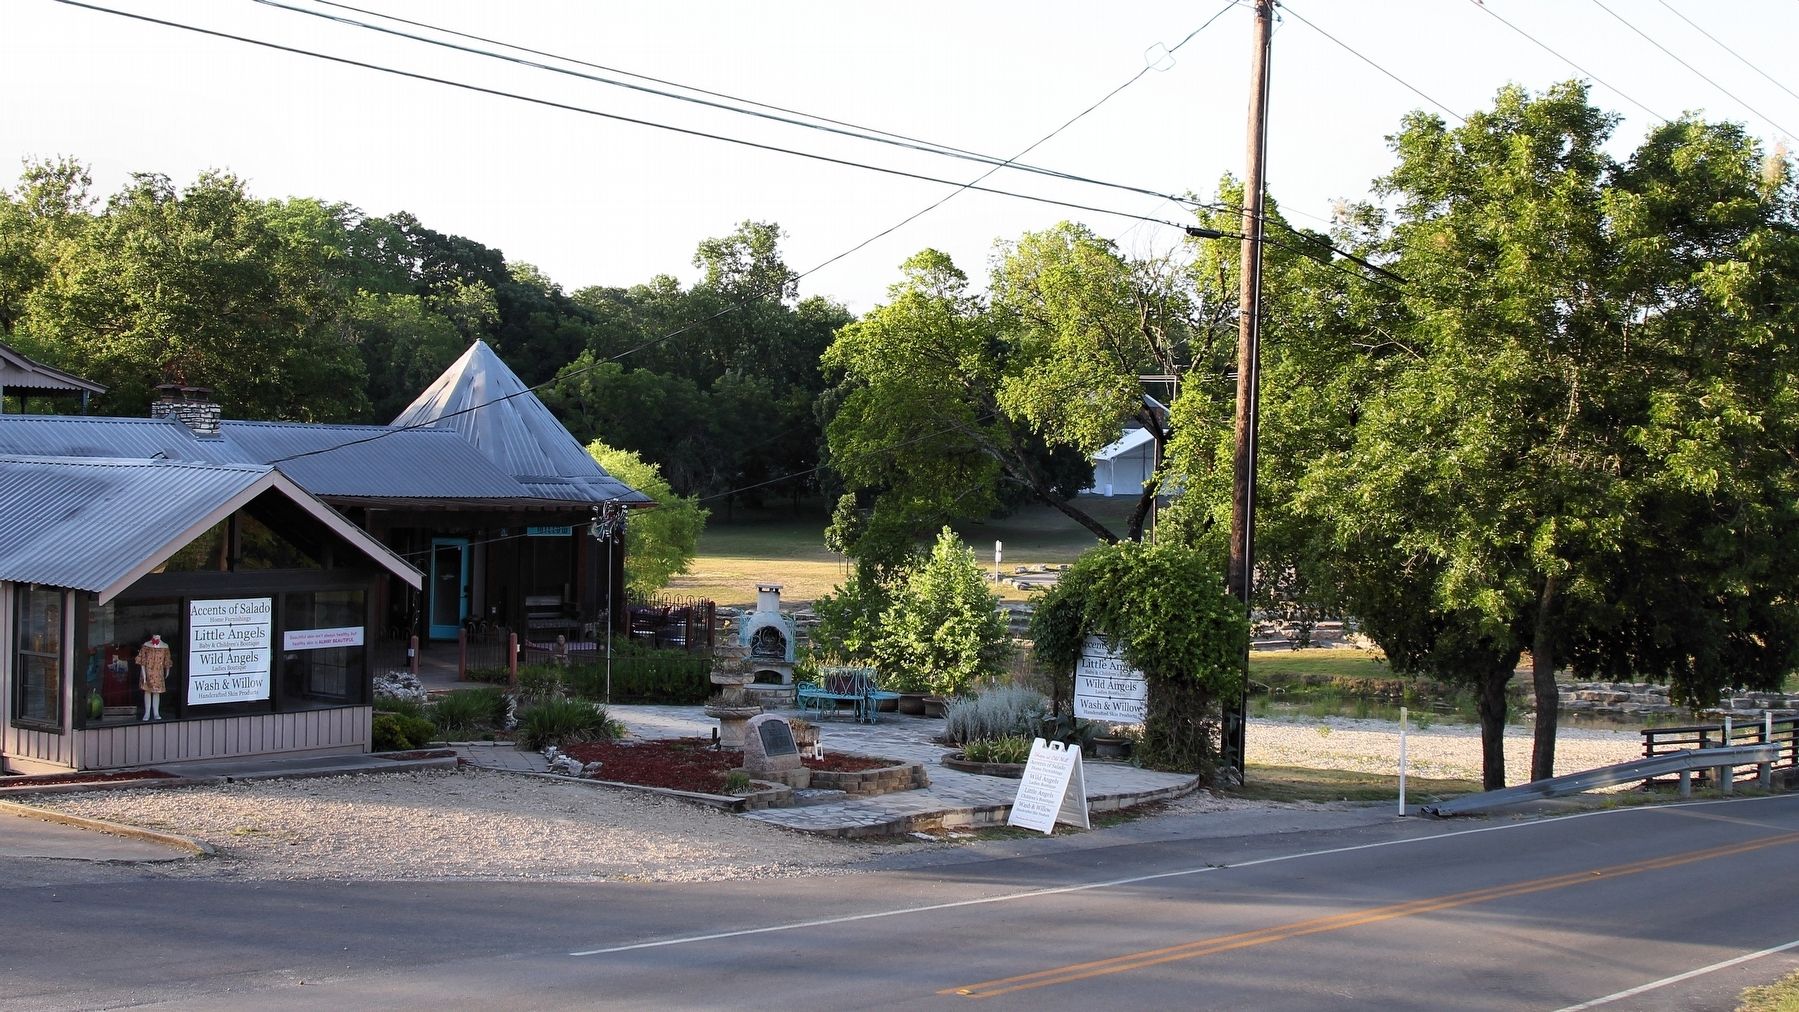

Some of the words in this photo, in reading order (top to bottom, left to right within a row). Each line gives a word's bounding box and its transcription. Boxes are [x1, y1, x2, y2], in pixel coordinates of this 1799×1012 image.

[191, 604, 227, 616] Accents
[229, 603, 239, 615] of
[240, 602, 270, 614] Salado
[195, 629, 225, 641] Little
[228, 627, 265, 641] Angels
[200, 652, 223, 665] Wild
[226, 651, 259, 666] Angels
[1081, 659, 1107, 670] Little
[195, 679, 220, 691] Wash
[222, 679, 230, 690] &
[232, 677, 263, 689] Willow
[1085, 679, 1105, 689] Wild
[1107, 680, 1137, 692] Angels
[1080, 699, 1102, 709] Wash
[1104, 701, 1110, 711] &
[1112, 702, 1142, 712] Willow
